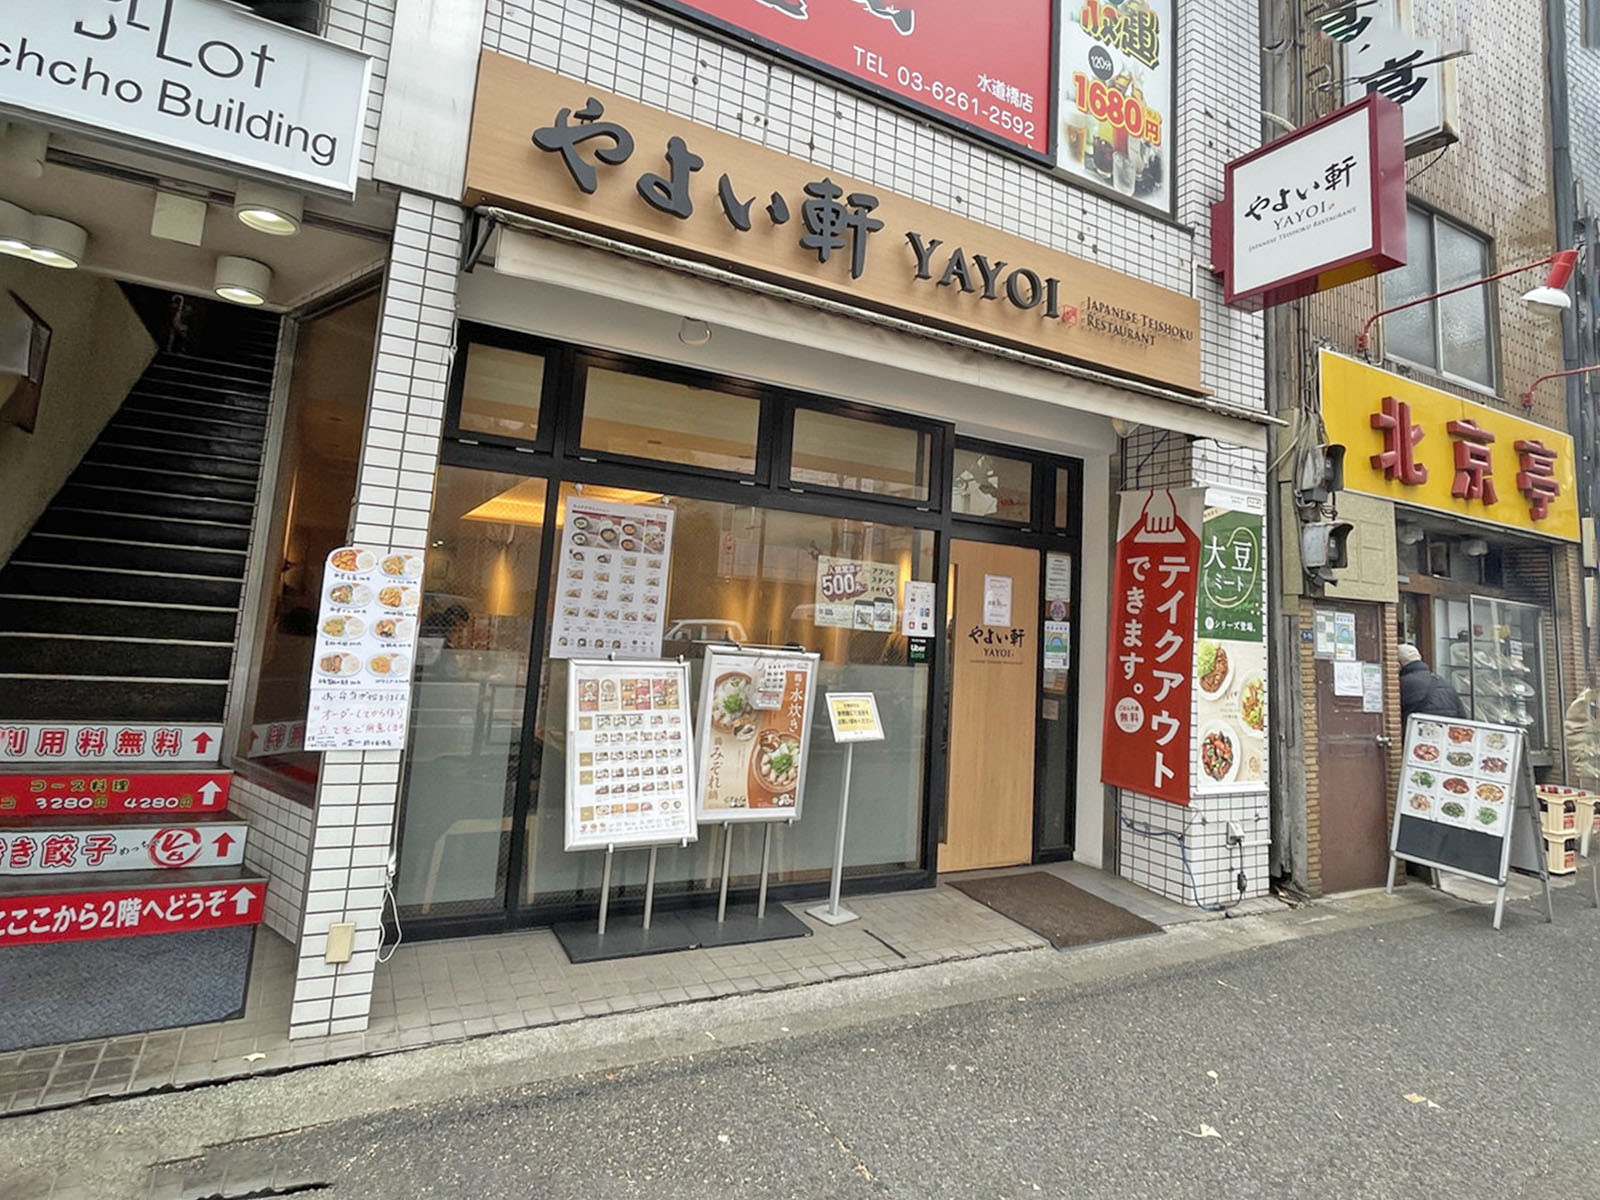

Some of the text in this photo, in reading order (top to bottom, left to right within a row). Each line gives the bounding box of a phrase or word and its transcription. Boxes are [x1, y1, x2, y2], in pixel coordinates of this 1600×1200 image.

[853, 45, 1035, 140] TEL 03-6261-2592
[976, 73, 1034, 113] 水道橋店
[157, 79, 337, 165] Building
[532, 96, 885, 281] やよい軒
[1244, 155, 1357, 221] やよい軒
[1273, 201, 1325, 231] YAYOI
[905, 231, 1061, 319] YAYOI
[1087, 313, 1155, 346] RESTAURANT
[1140, 314, 1193, 341] TEISHOKU
[1370, 396, 1560, 522] 北京亭
[1203, 535, 1253, 572] 大豆
[1215, 573, 1244, 592] ミート
[969, 626, 1025, 648] やよい軒
[1118, 555, 1151, 695] できます。
[984, 648, 1011, 658] YAYOI
[1150, 555, 1190, 788] テイクアウト
